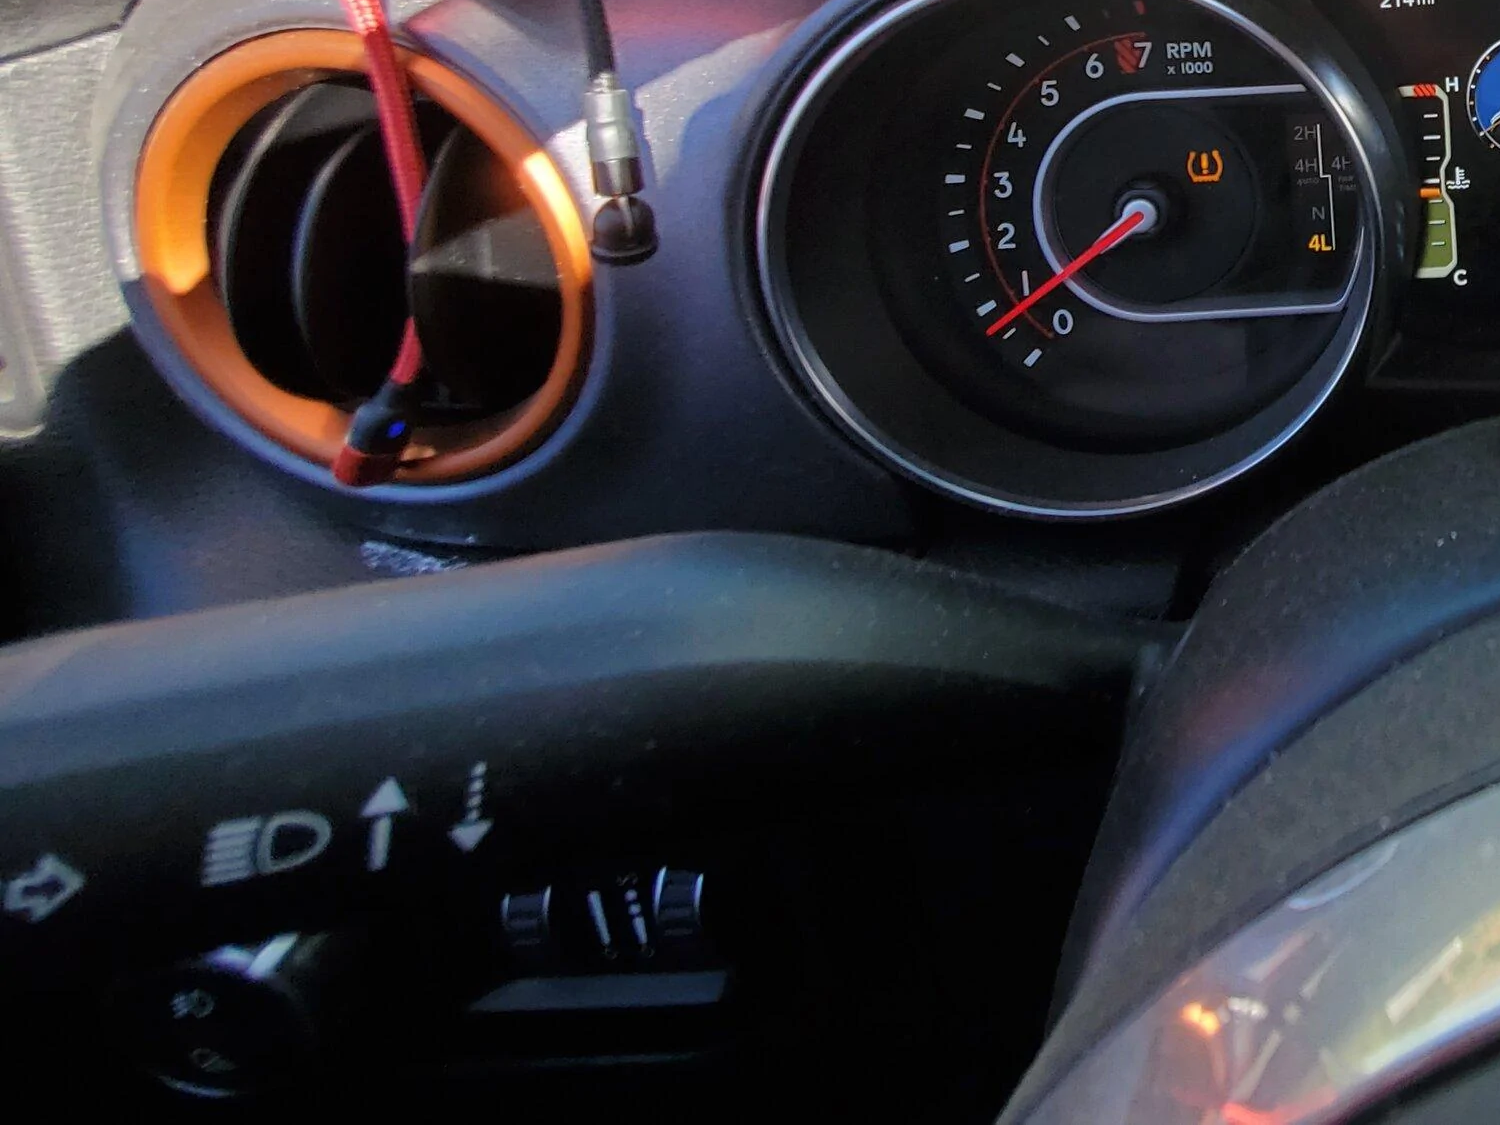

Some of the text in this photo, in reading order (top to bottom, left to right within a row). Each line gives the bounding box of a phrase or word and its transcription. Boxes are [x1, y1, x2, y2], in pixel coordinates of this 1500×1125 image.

[1133, 41, 1152, 69] 7
[1166, 41, 1212, 60] RPM
[1085, 53, 1104, 79] 6
[1181, 61, 1213, 75] 1000
[1040, 80, 1060, 107] 5
[1445, 76, 1459, 93] H
[1007, 122, 1026, 148] 4
[1294, 125, 1316, 141] 2H
[1294, 158, 1318, 173] 4H
[994, 172, 1013, 199] 3
[1312, 205, 1325, 220] N
[997, 223, 1016, 249] 2
[1308, 233, 1332, 252] 4L
[1453, 269, 1468, 286] C
[1052, 308, 1074, 335] 0
